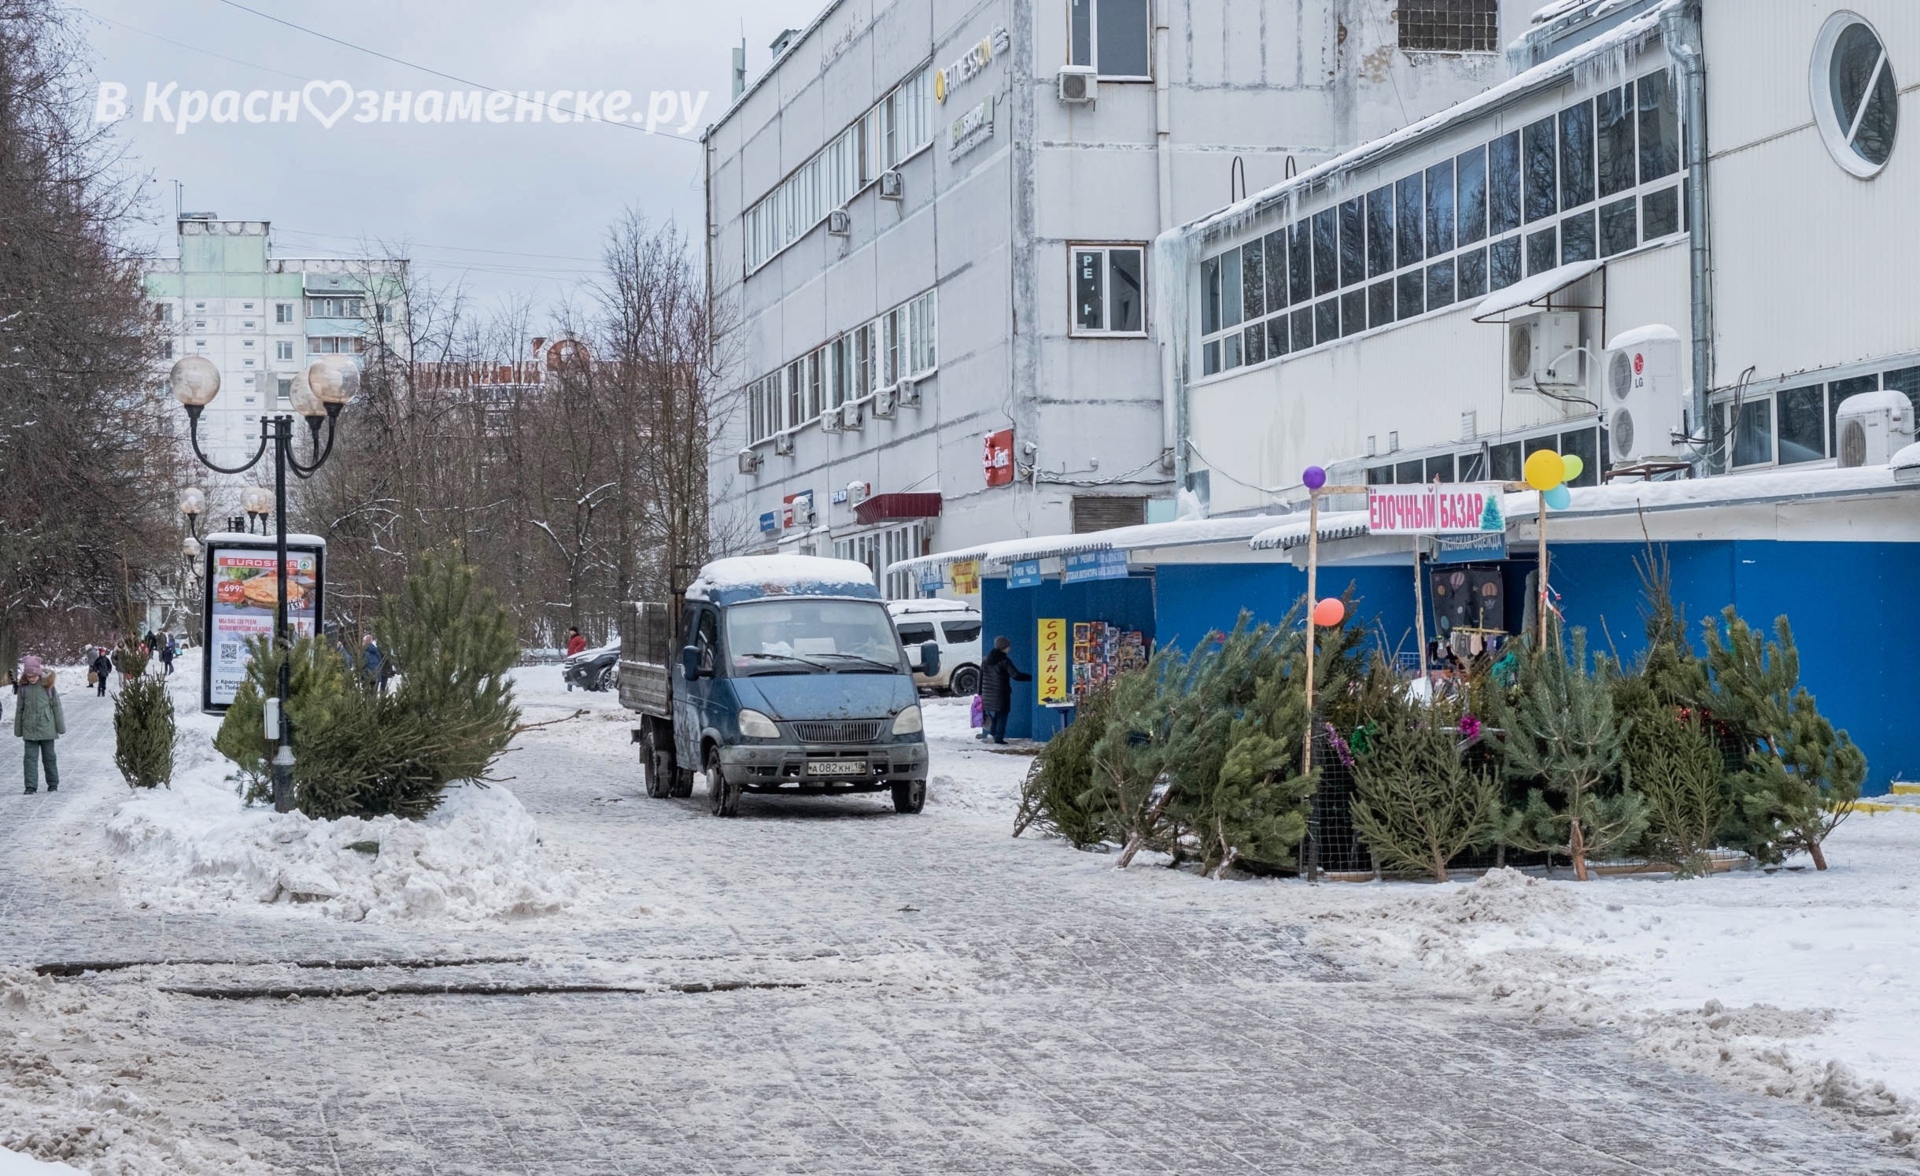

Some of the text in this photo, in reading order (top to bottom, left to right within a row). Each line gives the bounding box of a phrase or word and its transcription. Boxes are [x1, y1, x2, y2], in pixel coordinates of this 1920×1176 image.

[1635, 378, 1644, 389] LG
[1370, 486, 1483, 529] ЁЛОЧНЫЙ БАЗАР
[227, 559, 298, 568] EUROSPR
[1045, 620, 1060, 695] СОЛЕНЬЯ
